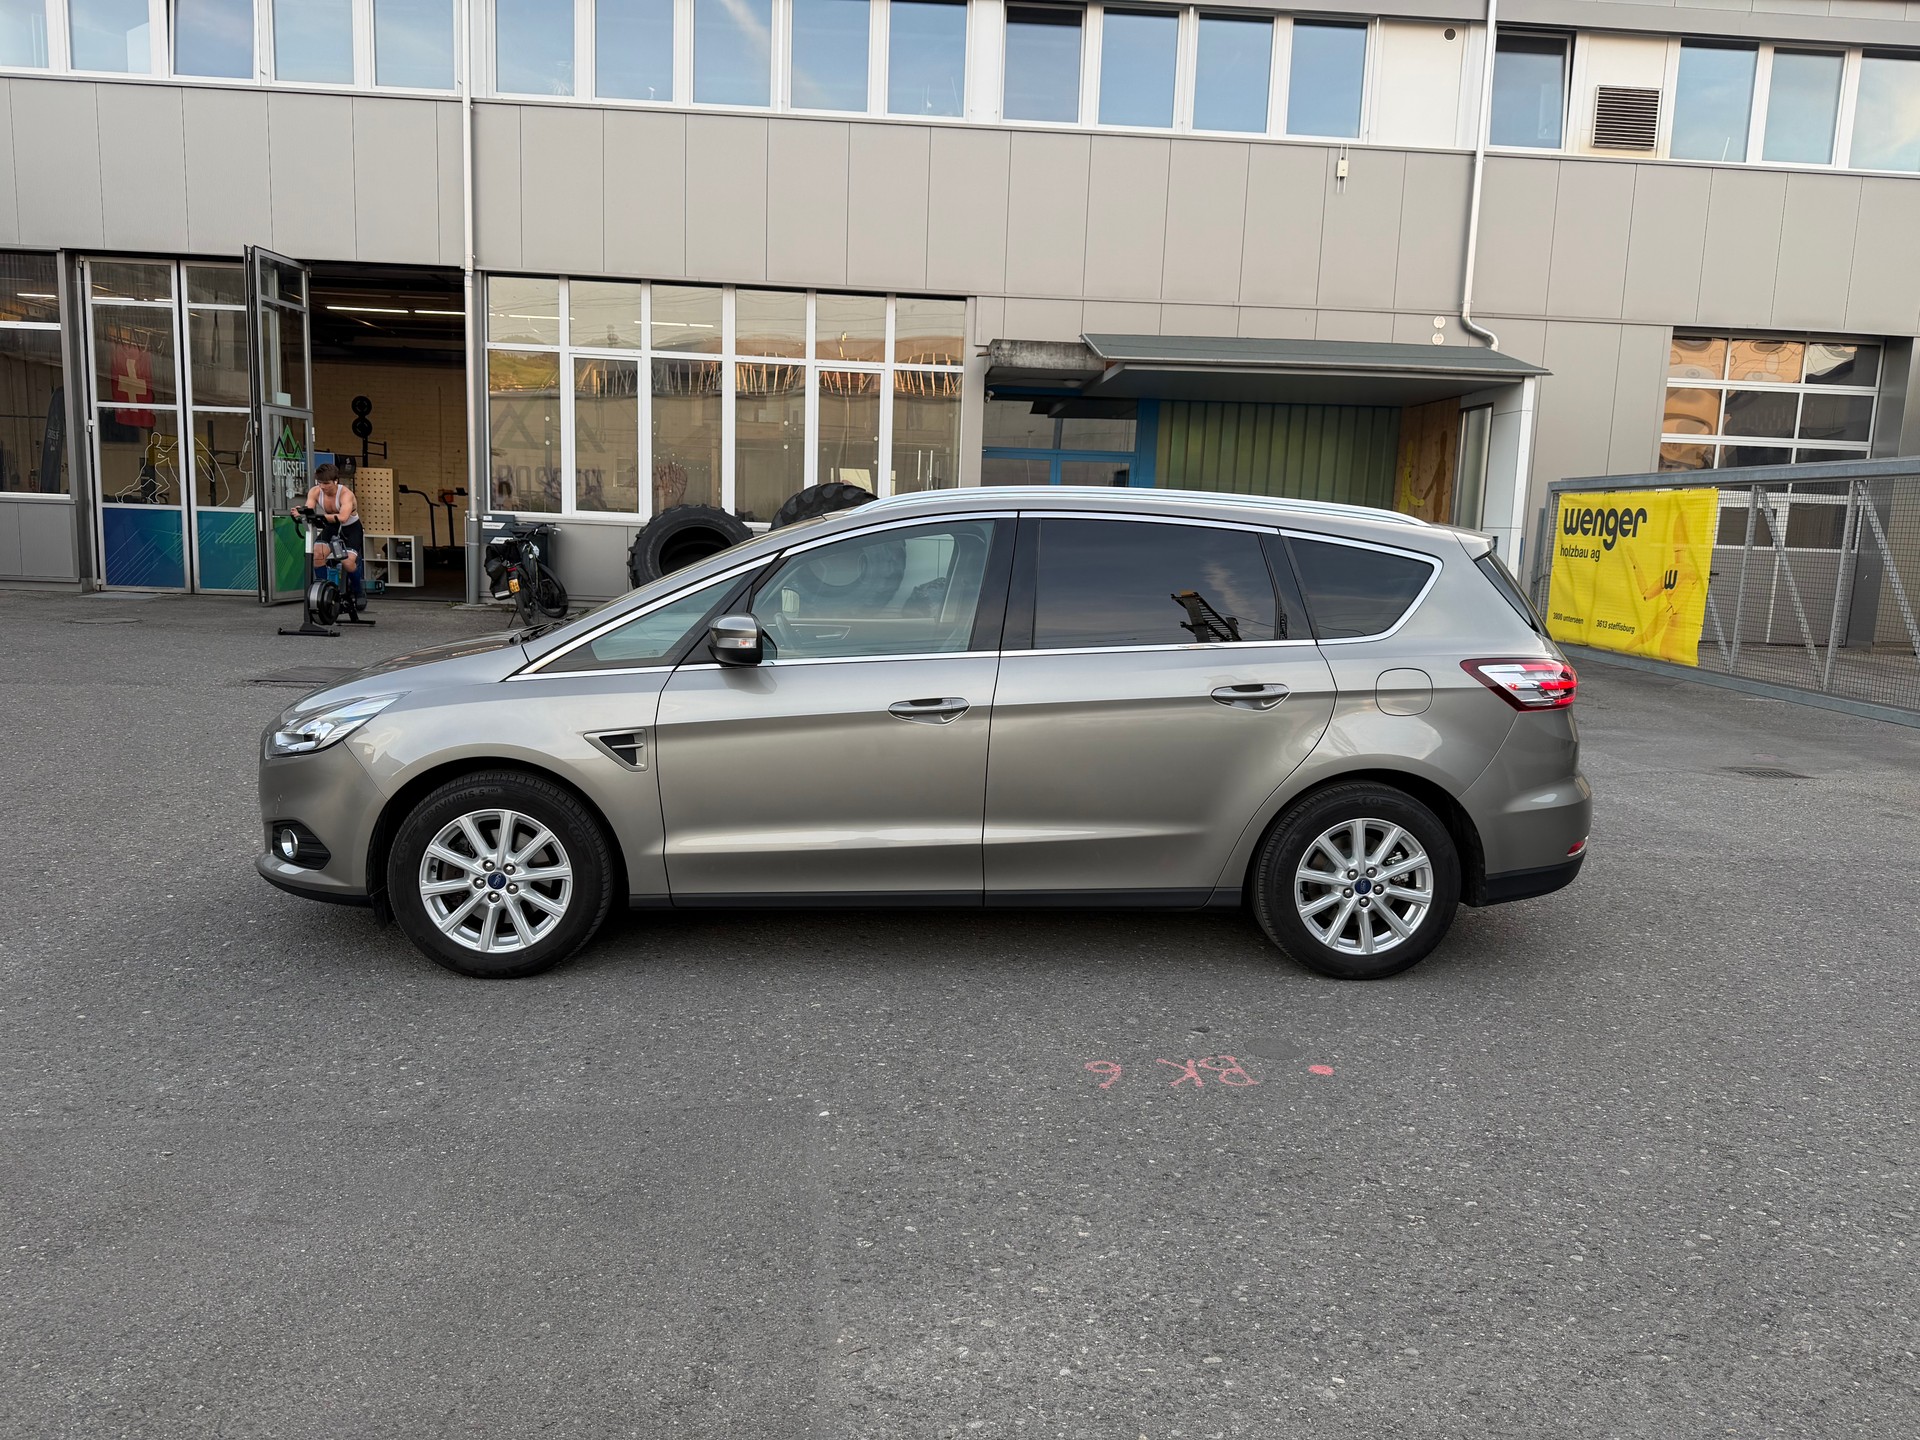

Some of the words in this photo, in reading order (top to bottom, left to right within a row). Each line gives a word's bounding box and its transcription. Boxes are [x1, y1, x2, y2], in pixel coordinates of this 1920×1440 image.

[272, 459, 306, 478] CROSSFIT
[1563, 507, 1648, 551] wenger
[1559, 543, 1589, 559] holzbau
[1590, 548, 1601, 563] ag
[1563, 615, 1584, 625] unterseen
[1595, 619, 1608, 629] 3613
[1608, 621, 1636, 635] steffisburg
[421, 790, 475, 822] BRAVURIS
